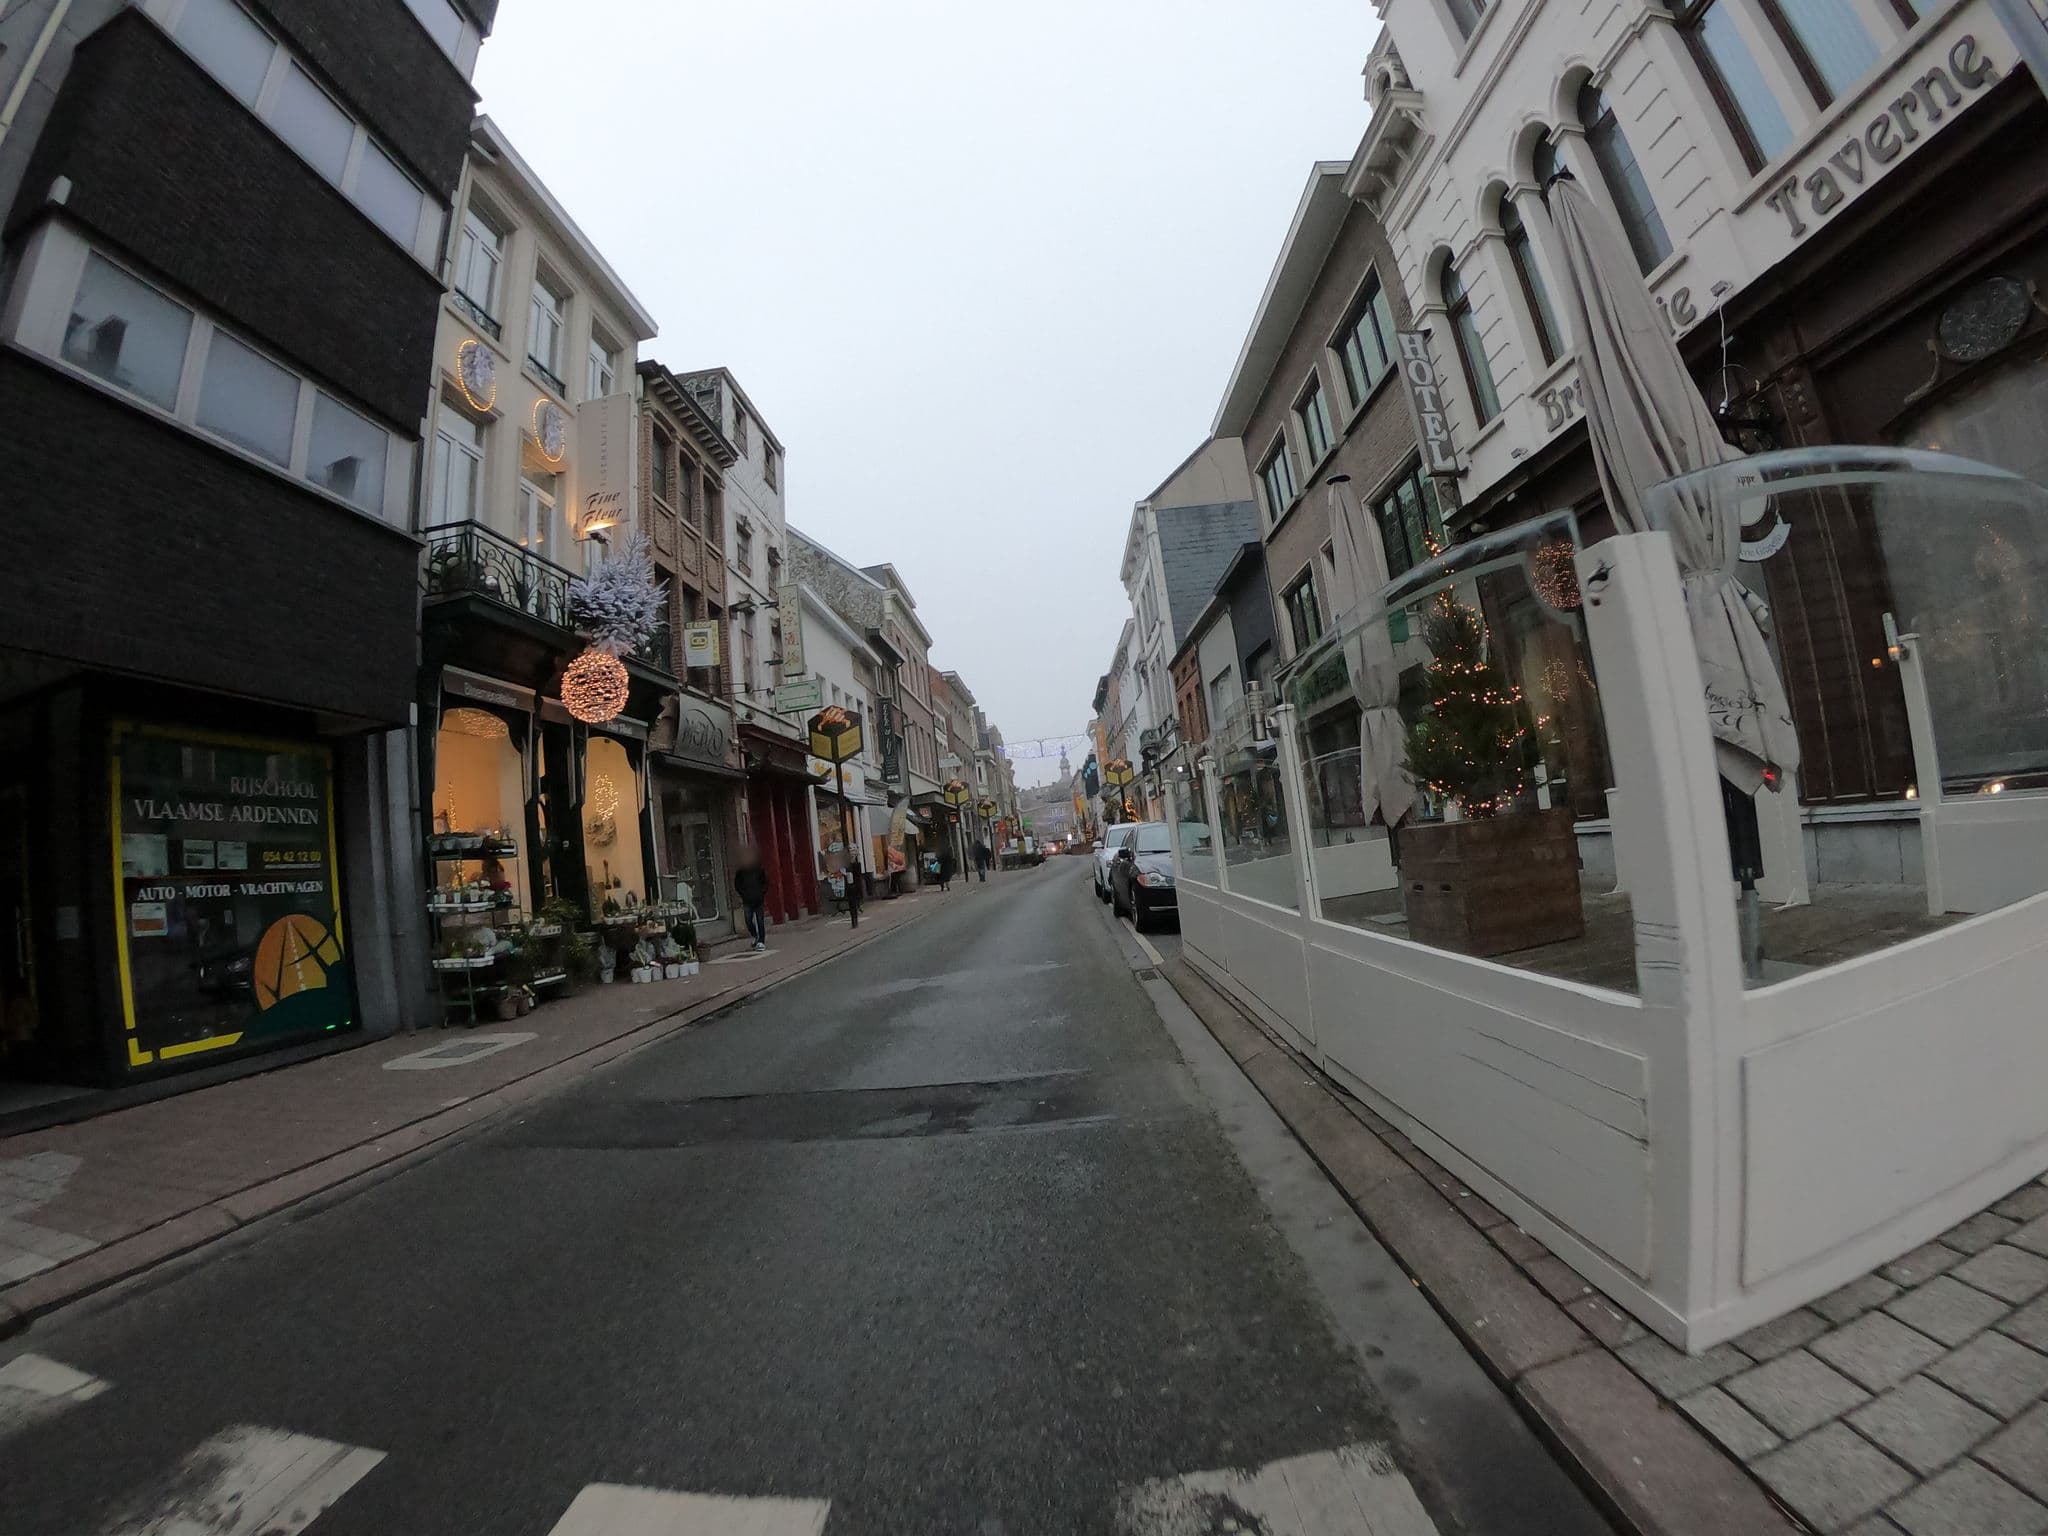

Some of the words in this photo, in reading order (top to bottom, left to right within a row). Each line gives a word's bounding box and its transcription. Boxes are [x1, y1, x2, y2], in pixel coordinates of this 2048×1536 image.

[1764, 34, 1994, 238] Taverne
[1398, 333, 1456, 471] HOTEL
[586, 491, 620, 510] Fine
[582, 509, 622, 527] Fleur
[230, 776, 319, 799] RIJSCHOOL
[134, 799, 225, 822] VLAAMSE
[229, 805, 319, 825] ARDENNEN
[137, 886, 176, 900] AUTO
[186, 884, 231, 898] MOTOR
[240, 880, 324, 897] VRACHTWAGEN
